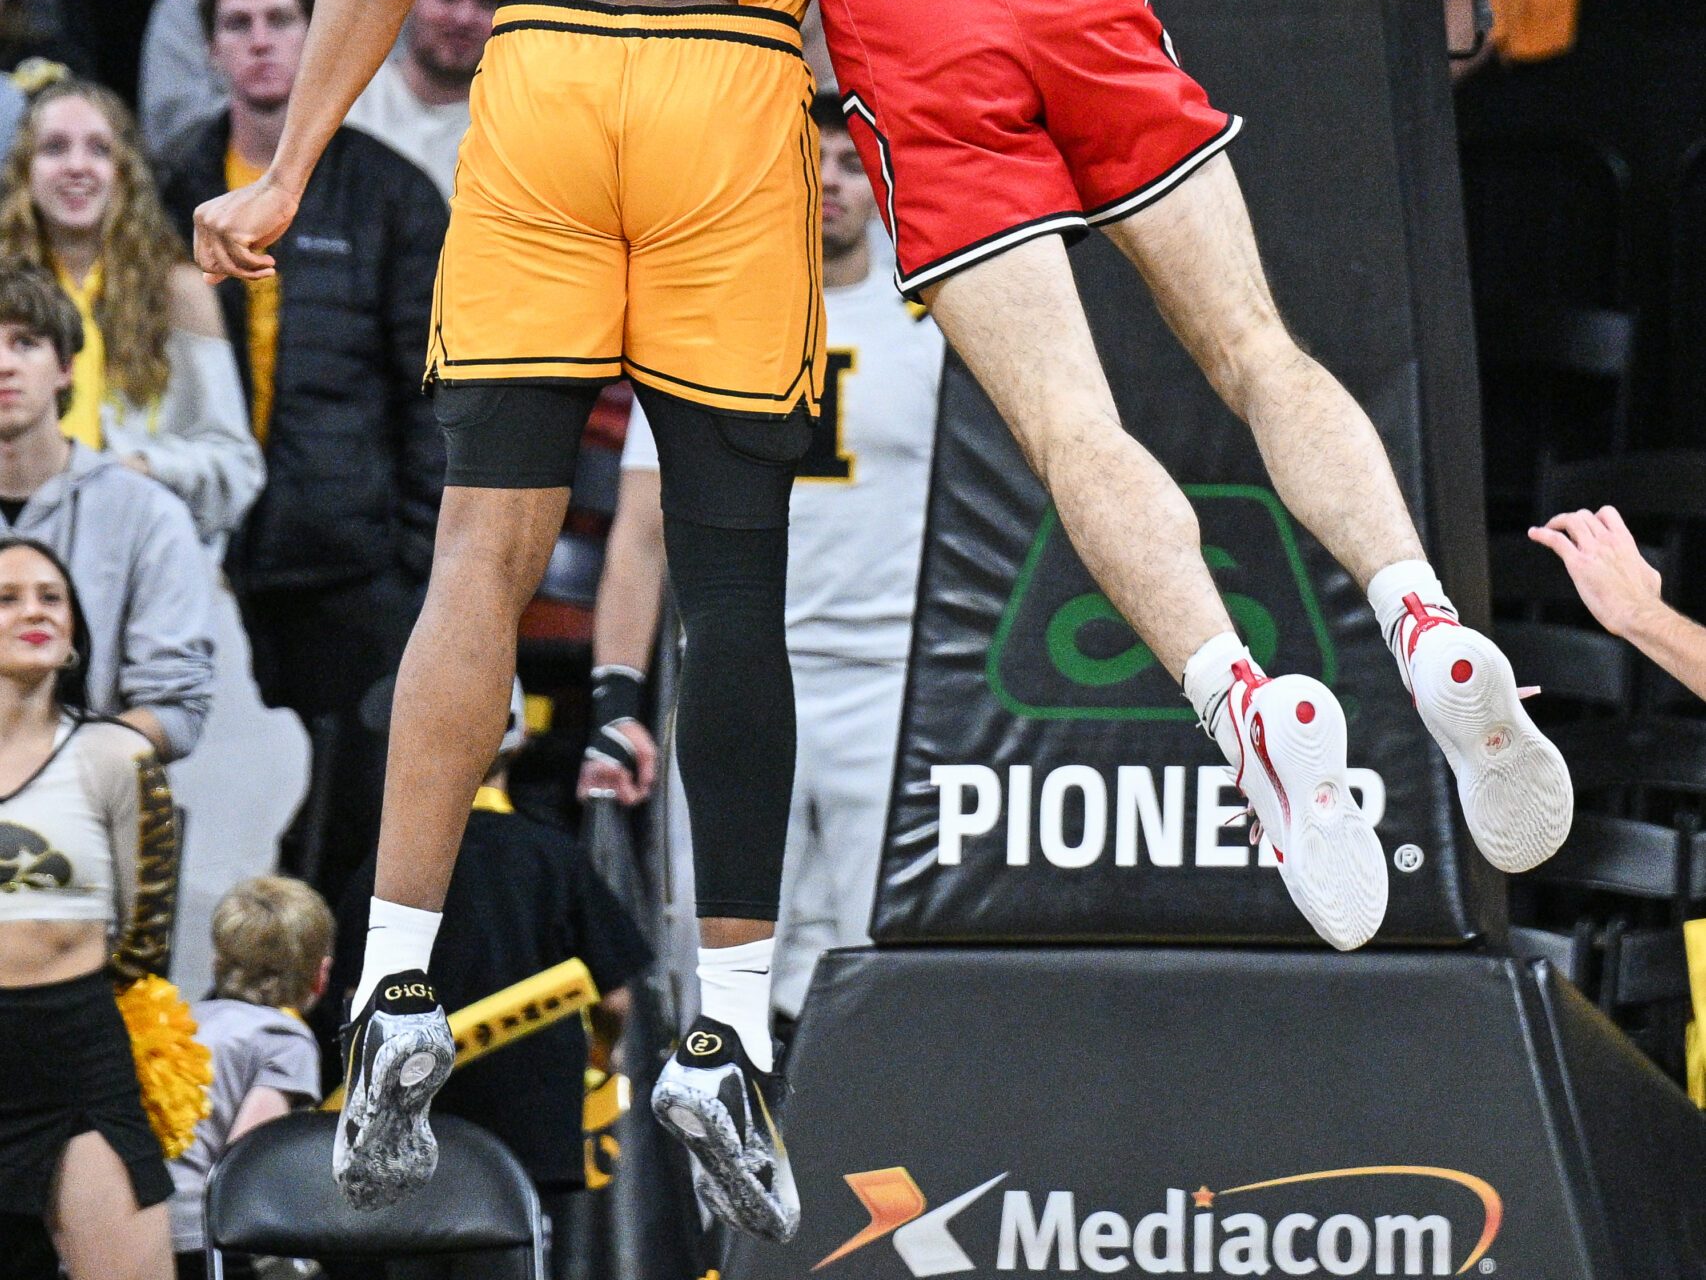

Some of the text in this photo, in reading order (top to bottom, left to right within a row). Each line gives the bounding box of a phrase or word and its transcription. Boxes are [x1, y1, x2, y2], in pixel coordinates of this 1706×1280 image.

[930, 764, 1387, 867] PIONE
[384, 983, 435, 1002] GiGi
[694, 1038, 709, 1052] 2
[996, 1187, 1452, 1277] Mediacom
